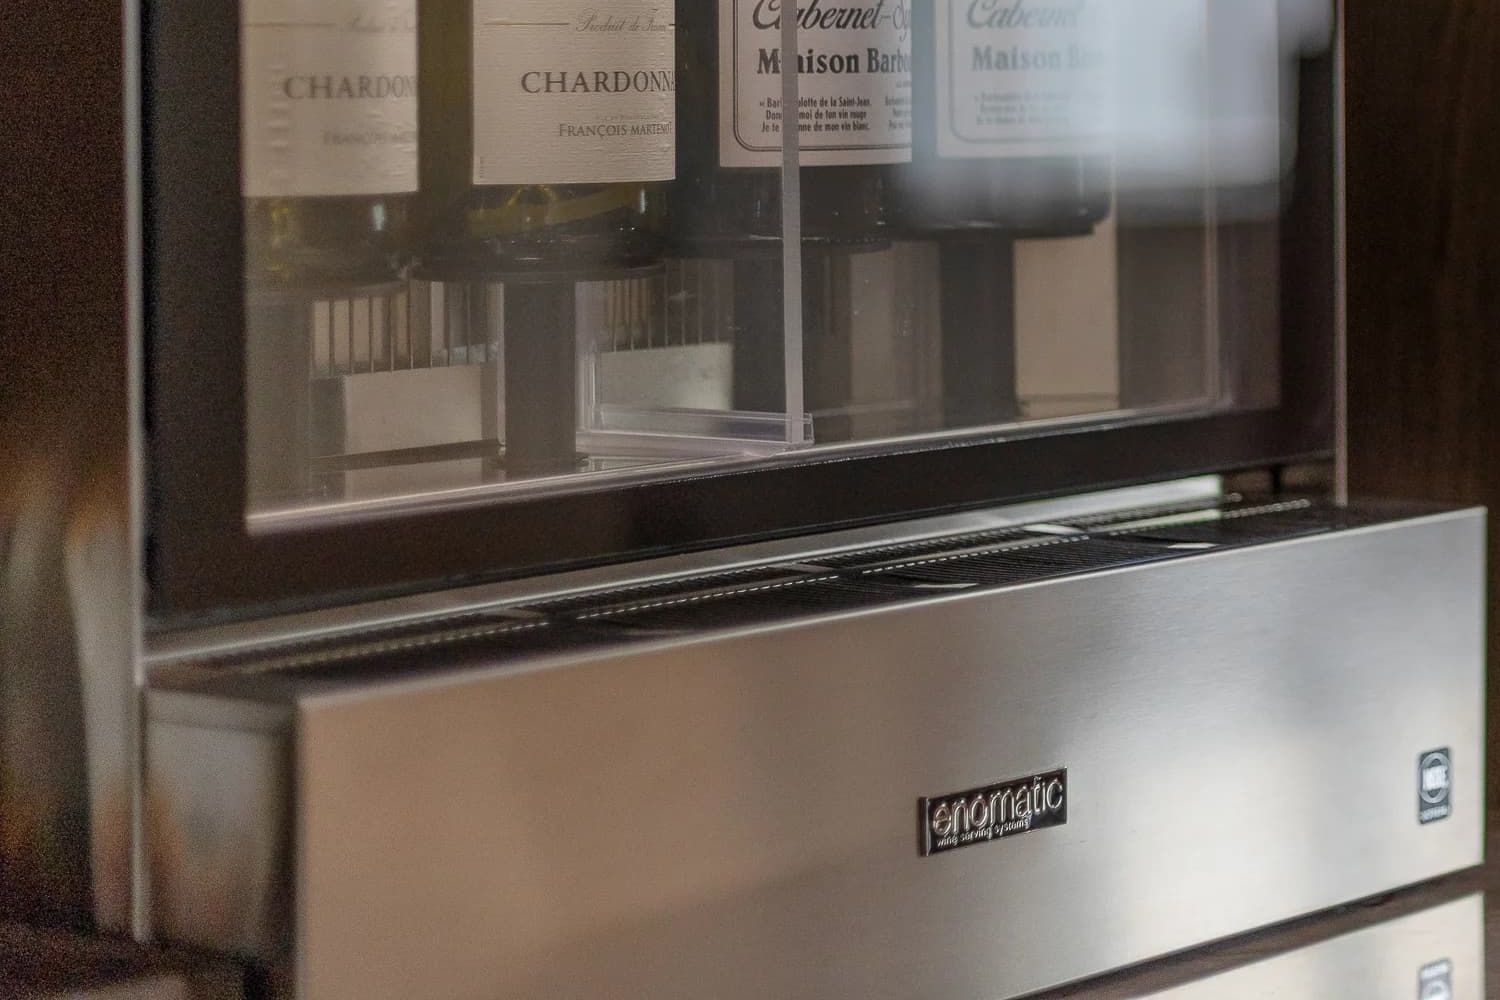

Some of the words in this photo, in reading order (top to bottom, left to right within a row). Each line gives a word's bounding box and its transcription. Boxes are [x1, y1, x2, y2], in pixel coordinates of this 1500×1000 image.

[757, 49, 860, 75] Mison
[972, 44, 1061, 72] Maison
[559, 123, 627, 138] FRANÇOIS
[932, 776, 1063, 837] enomatic
[960, 824, 992, 840] serving
[994, 815, 1031, 838] systems
